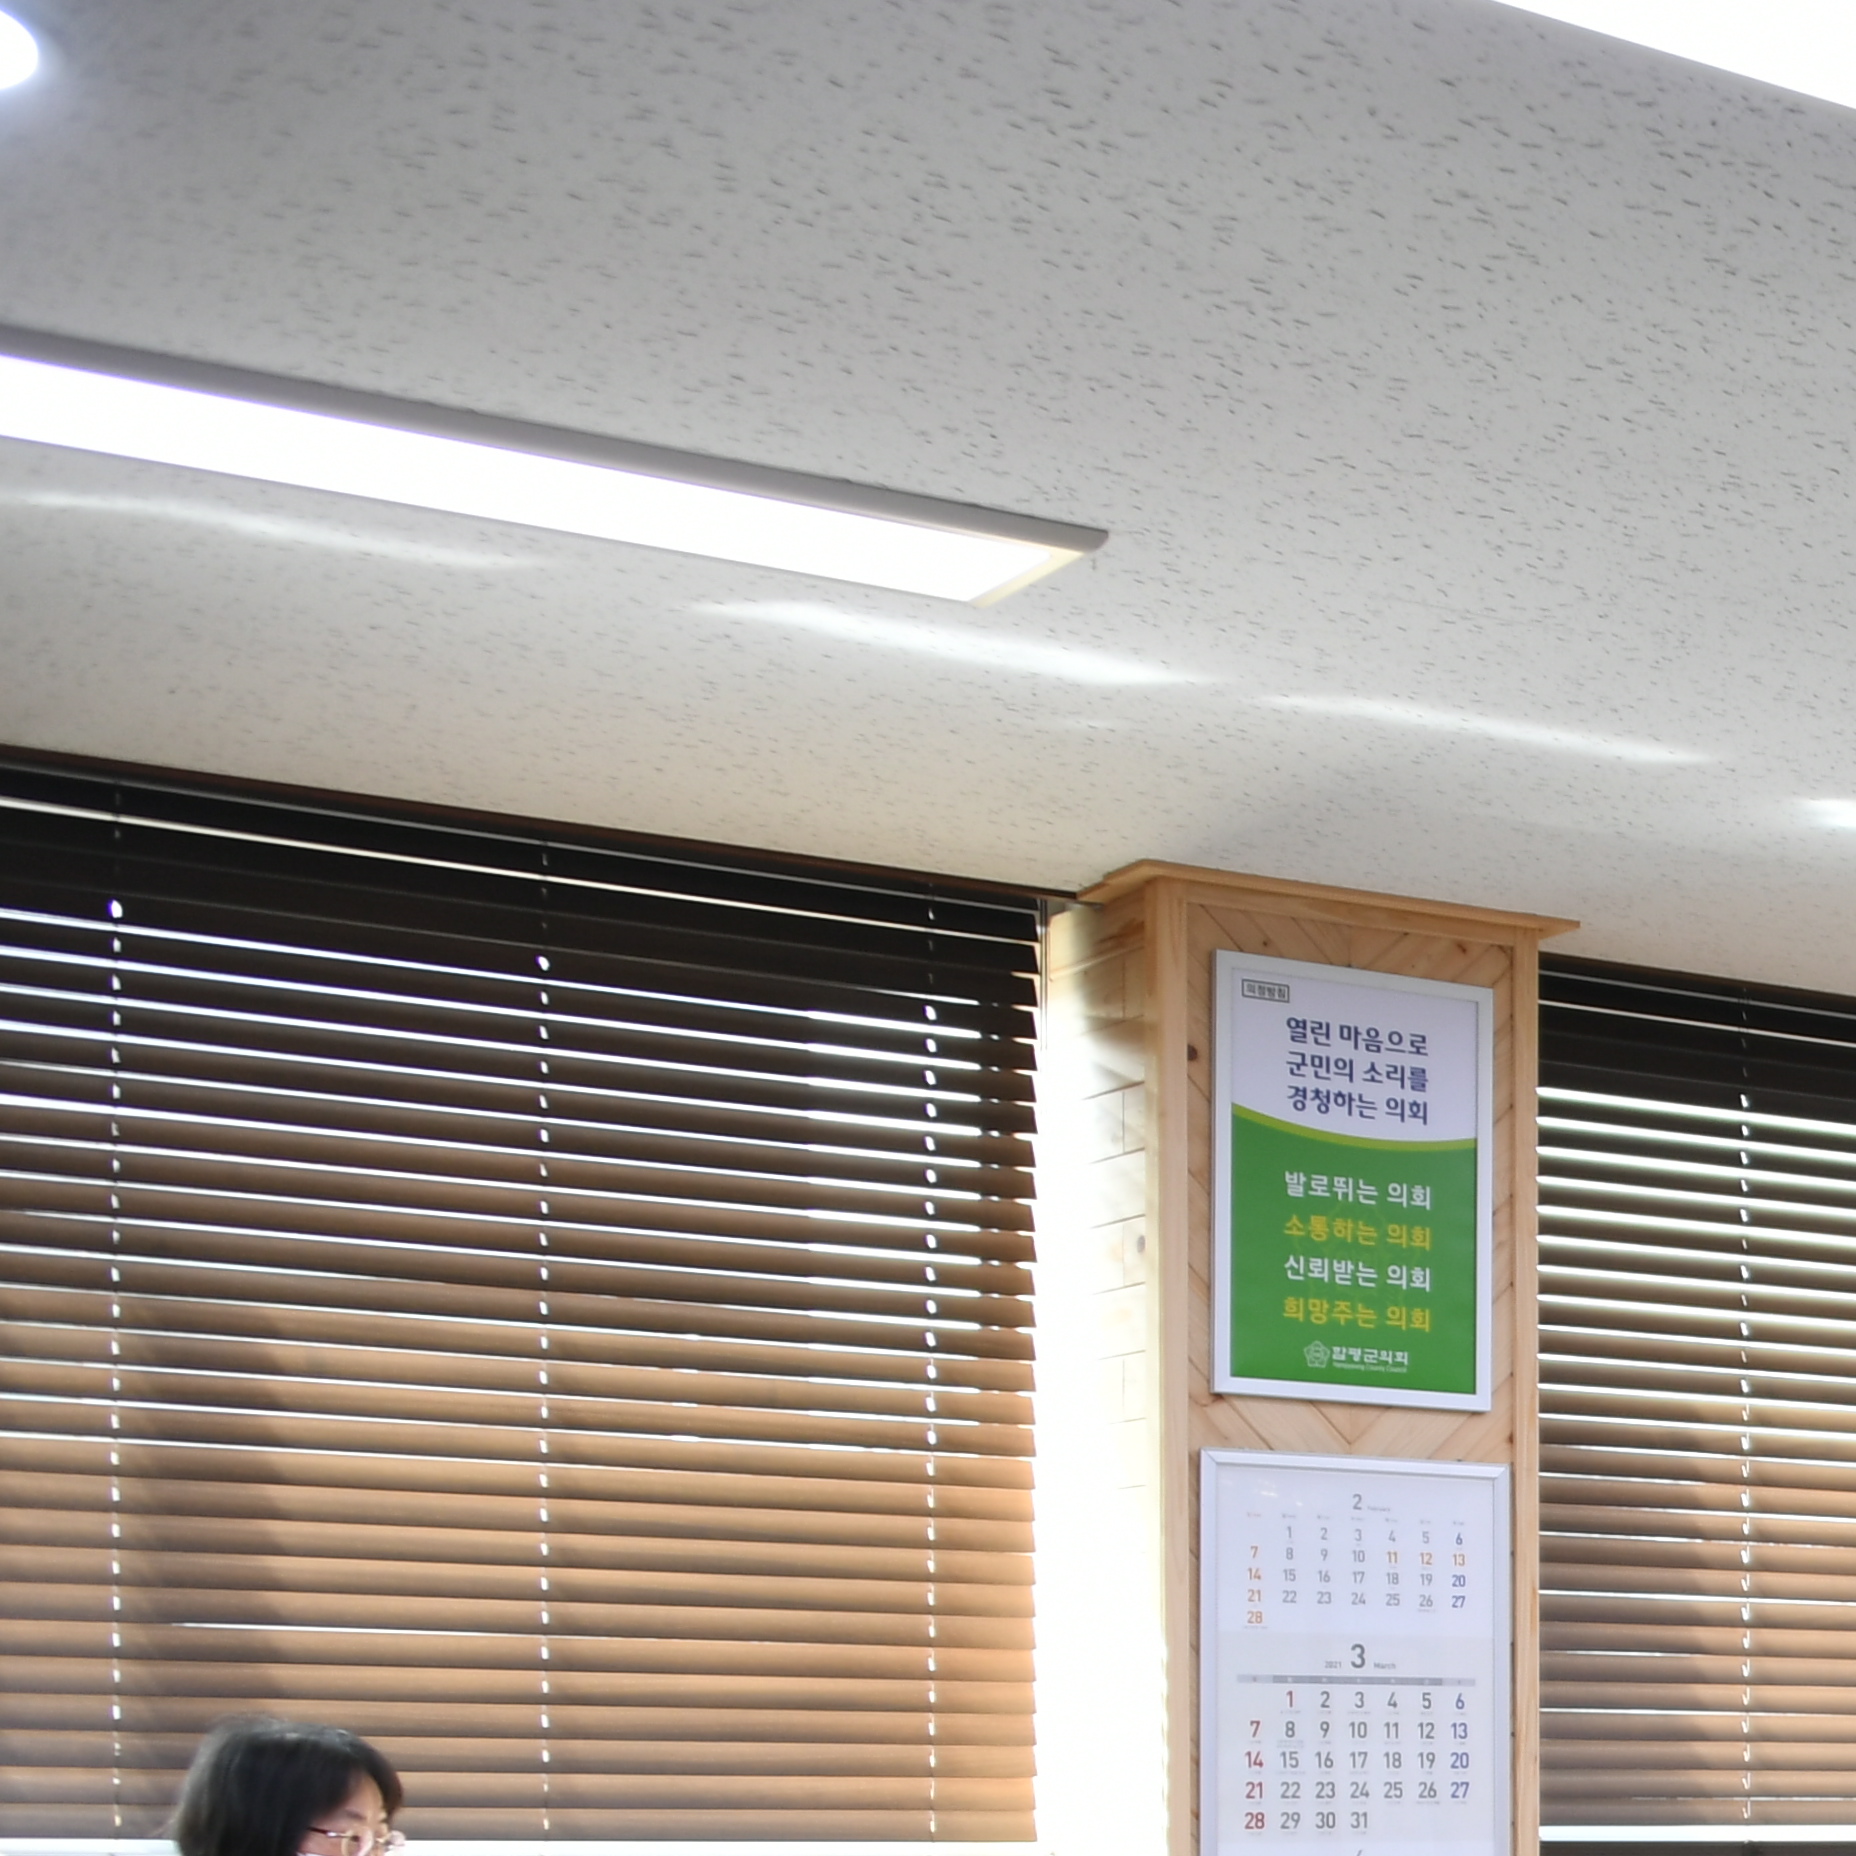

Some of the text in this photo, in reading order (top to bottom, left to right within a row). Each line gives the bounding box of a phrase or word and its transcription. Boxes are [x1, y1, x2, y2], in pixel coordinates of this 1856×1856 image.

[1286, 1016, 1428, 1056] 열린 마음으로
[1286, 1051, 1428, 1092] 군민의 소리를
[1287, 1085, 1428, 1126] 경청하는 의회
[1285, 1171, 1431, 1210] 발로뛰는 의회
[1284, 1214, 1431, 1251] 소통하는 의회
[1284, 1254, 1431, 1292] 신뢰받는 의회
[1283, 1297, 1431, 1332] 희망주는 의회
[1352, 1494, 1362, 1510] 2
[1285, 1526, 1464, 1545] 1 2 3 4 5 6
[1250, 1546, 1465, 1566] 7 8 9 10 11 12 13
[1248, 1568, 1466, 1587] 14 15 16 17 18 19 20
[1248, 1590, 1465, 1608] 21 22 23 24 25 26 27
[1247, 1611, 1263, 1623] 28
[1351, 1644, 1366, 1669] 3
[1285, 1691, 1464, 1709] 1 2 3 4 5 6
[1250, 1721, 1468, 1739] 7 8 9 10 11 12 13
[1245, 1752, 1469, 1768] 14 15 16 17 18 19 20
[1246, 1782, 1469, 1799] 21 22 23 24 25 26 27
[1245, 1812, 1367, 1829] 28 29 30 31
